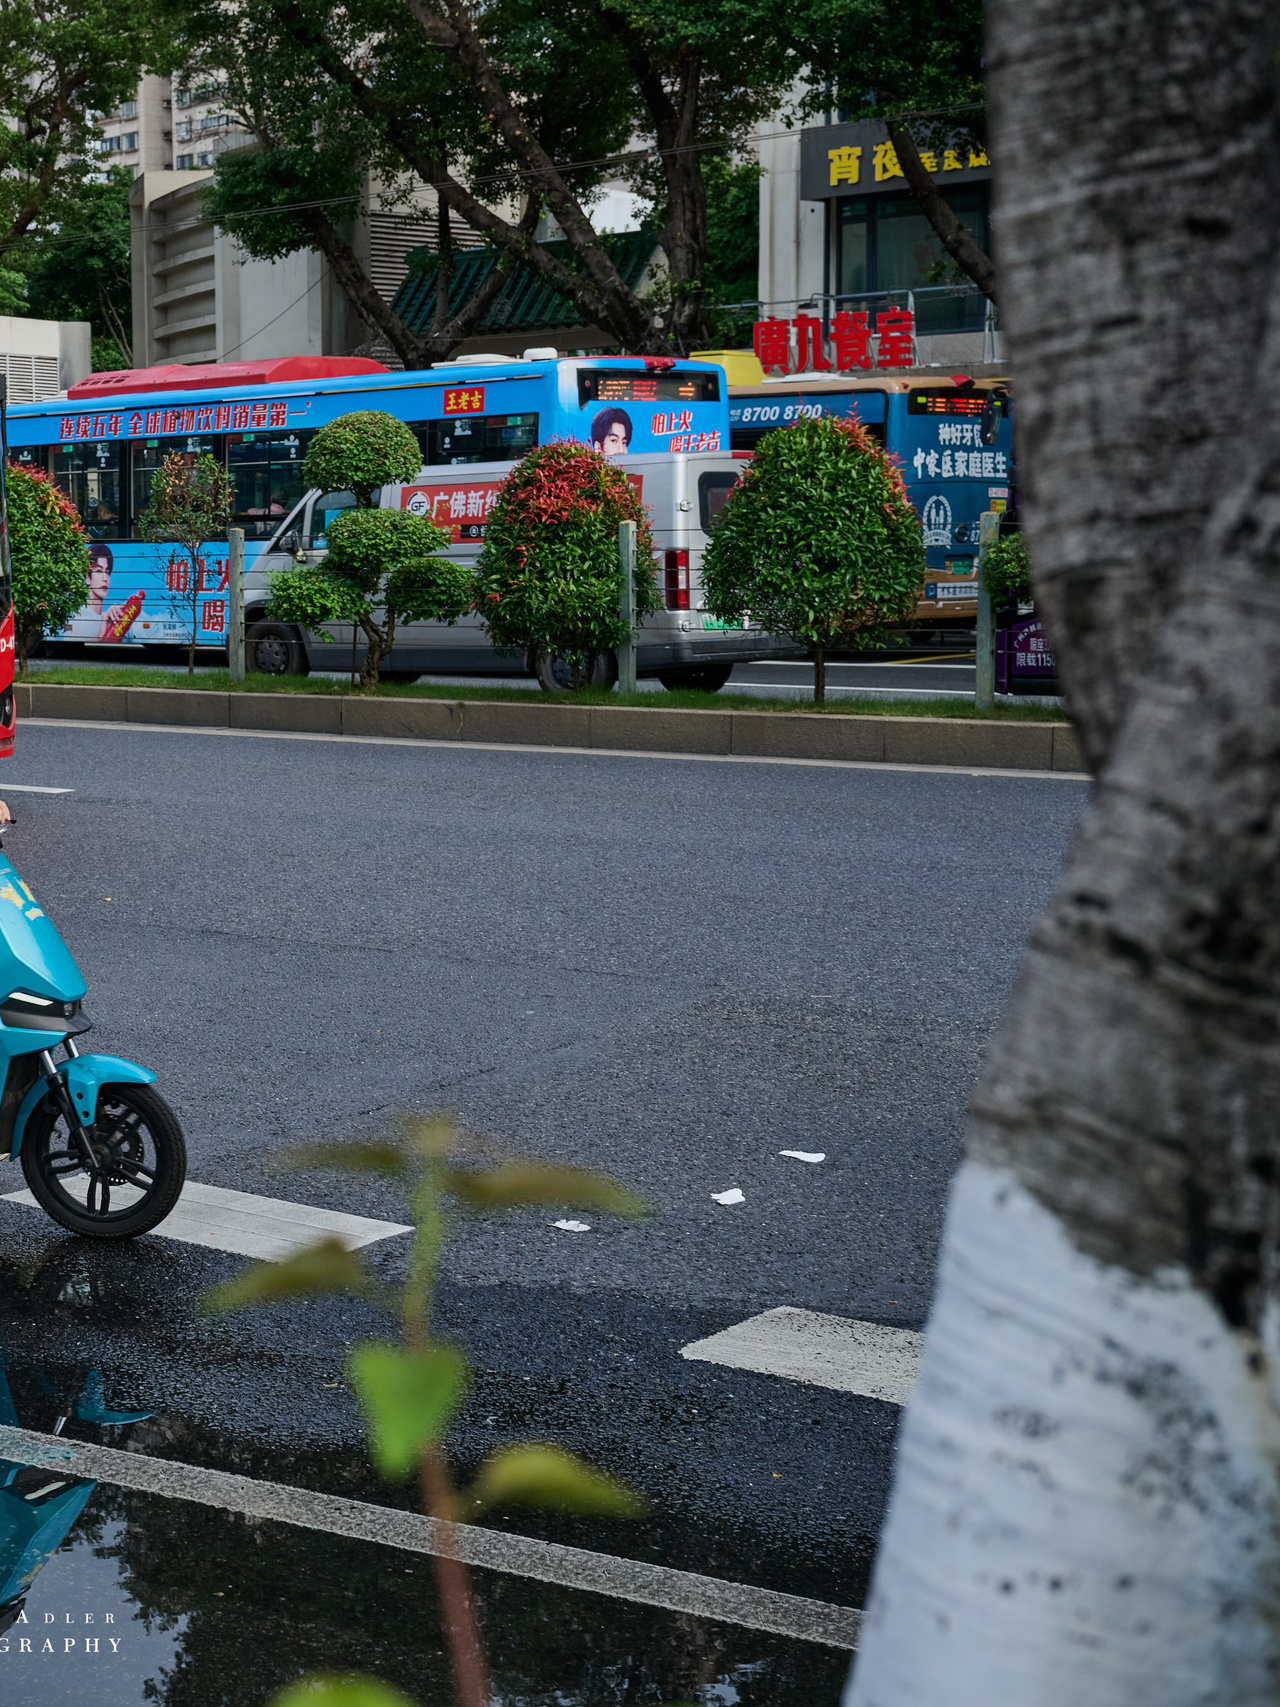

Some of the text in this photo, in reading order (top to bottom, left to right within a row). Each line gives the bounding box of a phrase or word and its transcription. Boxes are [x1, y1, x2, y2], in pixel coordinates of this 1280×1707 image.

[753, 306, 914, 375] 廣九餐室
[445, 390, 483, 411] 王老吉
[742, 404, 822, 422] 8700 8700
[59, 402, 307, 440] 连续五年 全球植物饮料销量第一
[651, 409, 694, 436] 怕上火
[201, 599, 226, 633] 喝
